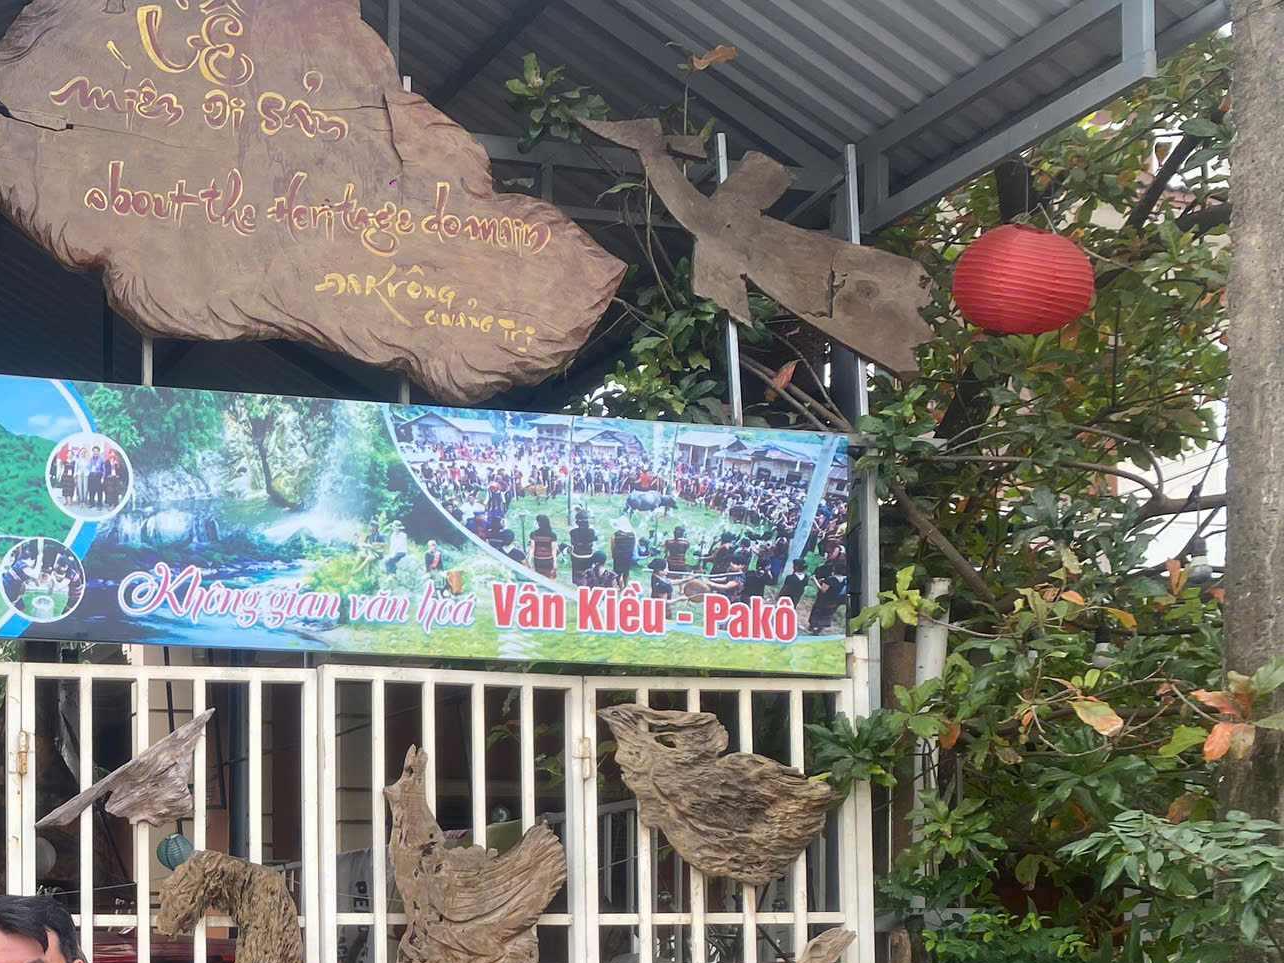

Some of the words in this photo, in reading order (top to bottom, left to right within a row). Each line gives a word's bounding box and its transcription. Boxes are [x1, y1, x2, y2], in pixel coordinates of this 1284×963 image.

[84, 161, 200, 228] about
[199, 168, 256, 236] the
[421, 181, 552, 257] domain
[118, 562, 260, 627] Không
[267, 583, 341, 628] gian
[349, 590, 409, 623] văn
[416, 580, 477, 633] hoá
[493, 583, 566, 629] Vân
[577, 583, 666, 635] Kiều
[704, 594, 797, 642] Pakô
